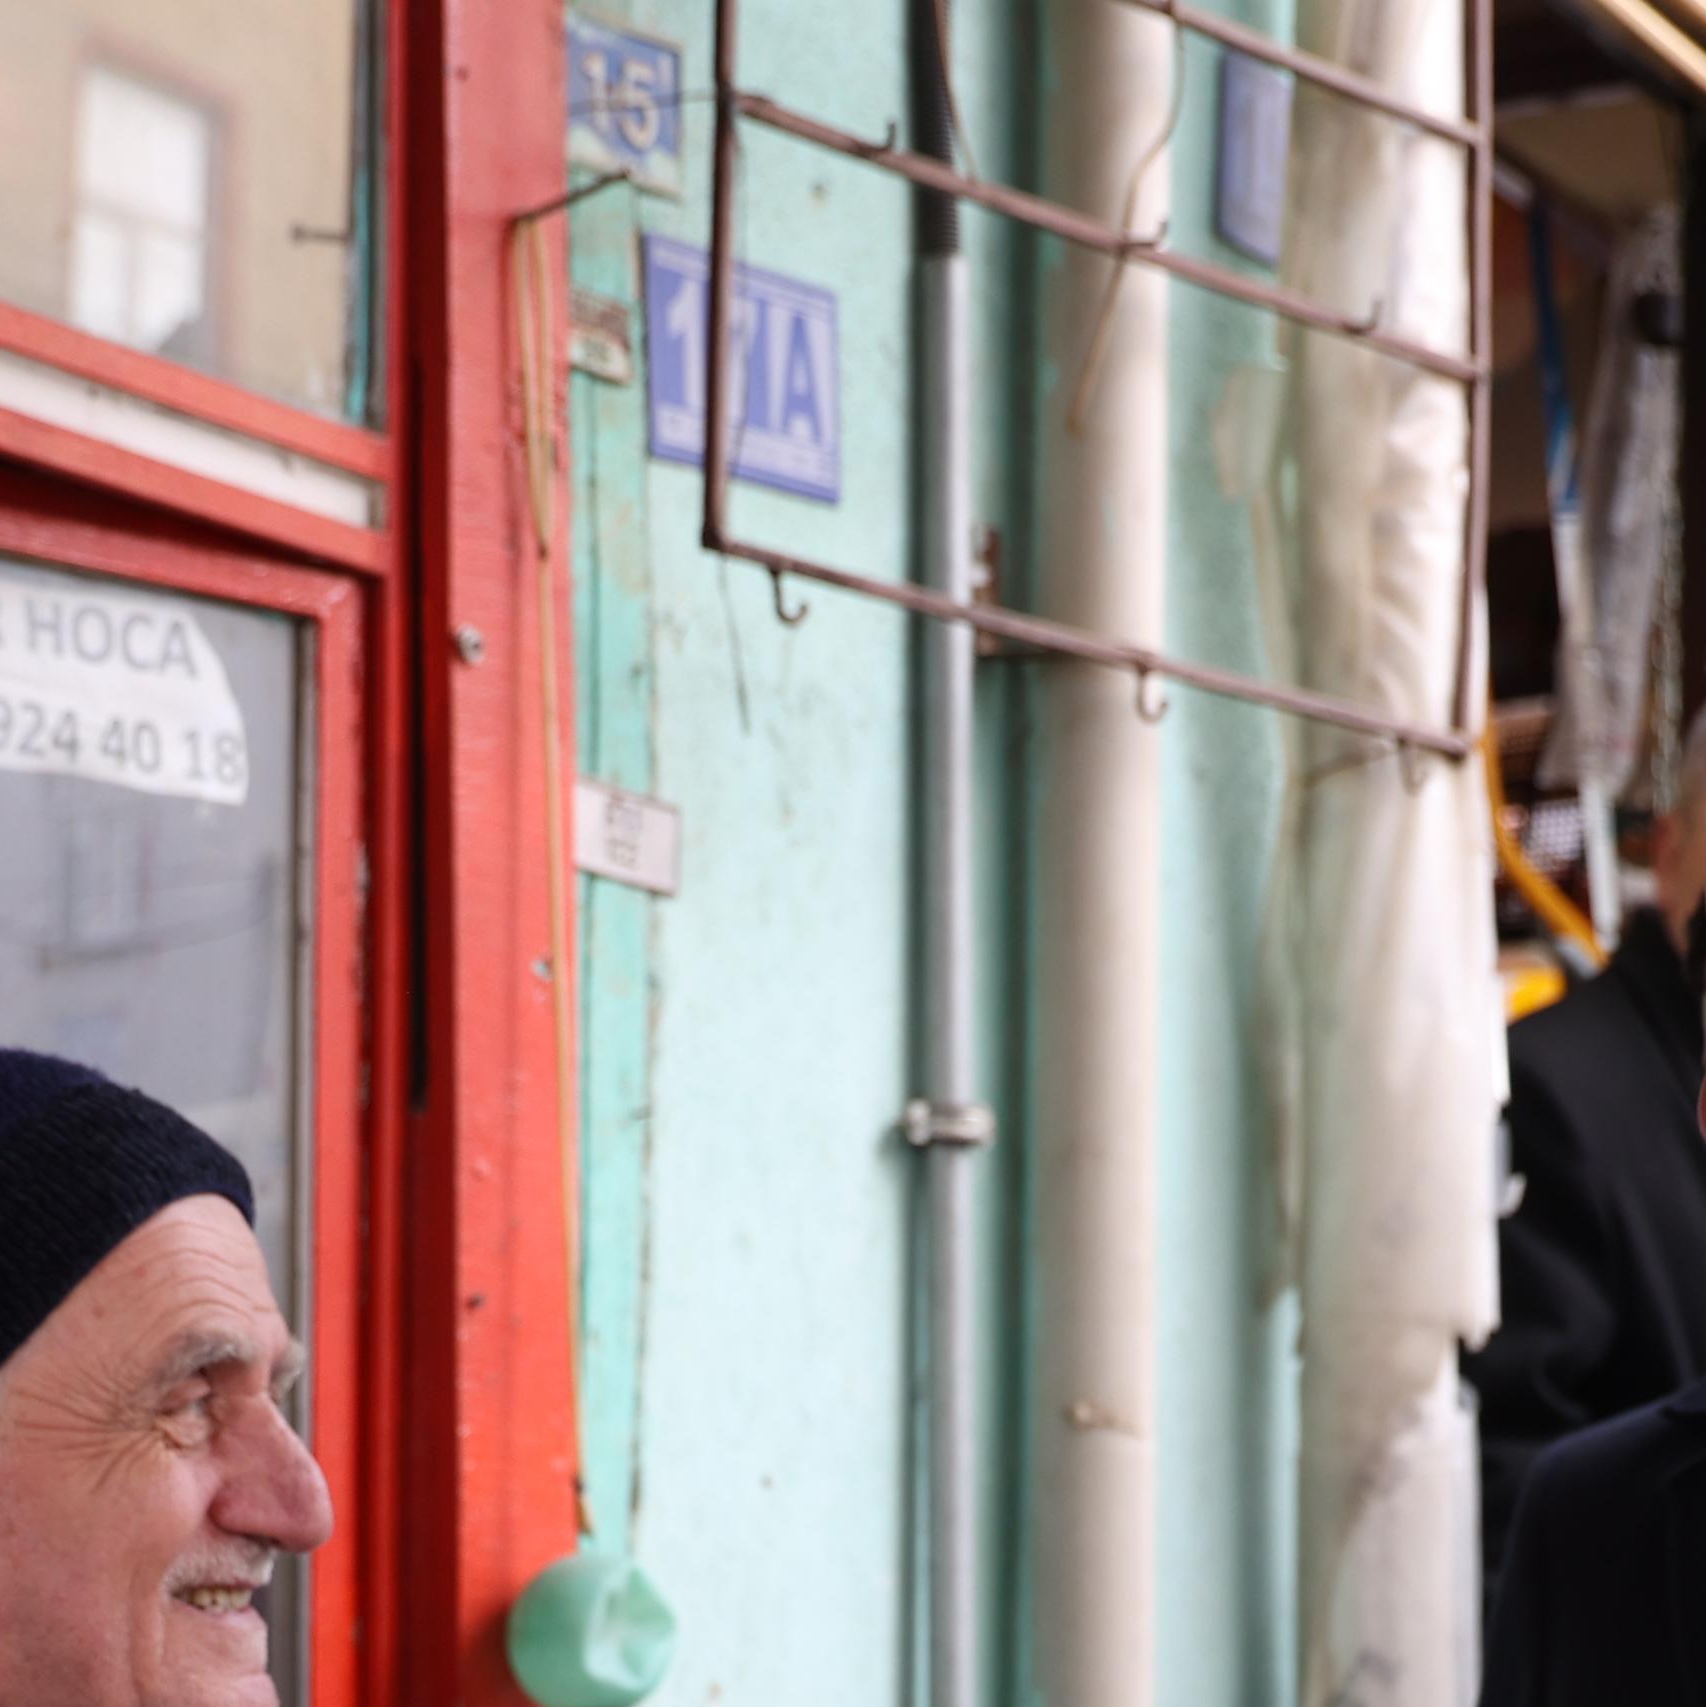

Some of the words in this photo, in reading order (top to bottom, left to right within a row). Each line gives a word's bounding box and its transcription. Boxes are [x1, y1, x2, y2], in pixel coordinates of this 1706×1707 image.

[24, 597, 199, 678] HOCA
[99, 717, 162, 774] 40
[183, 728, 245, 786] 18
